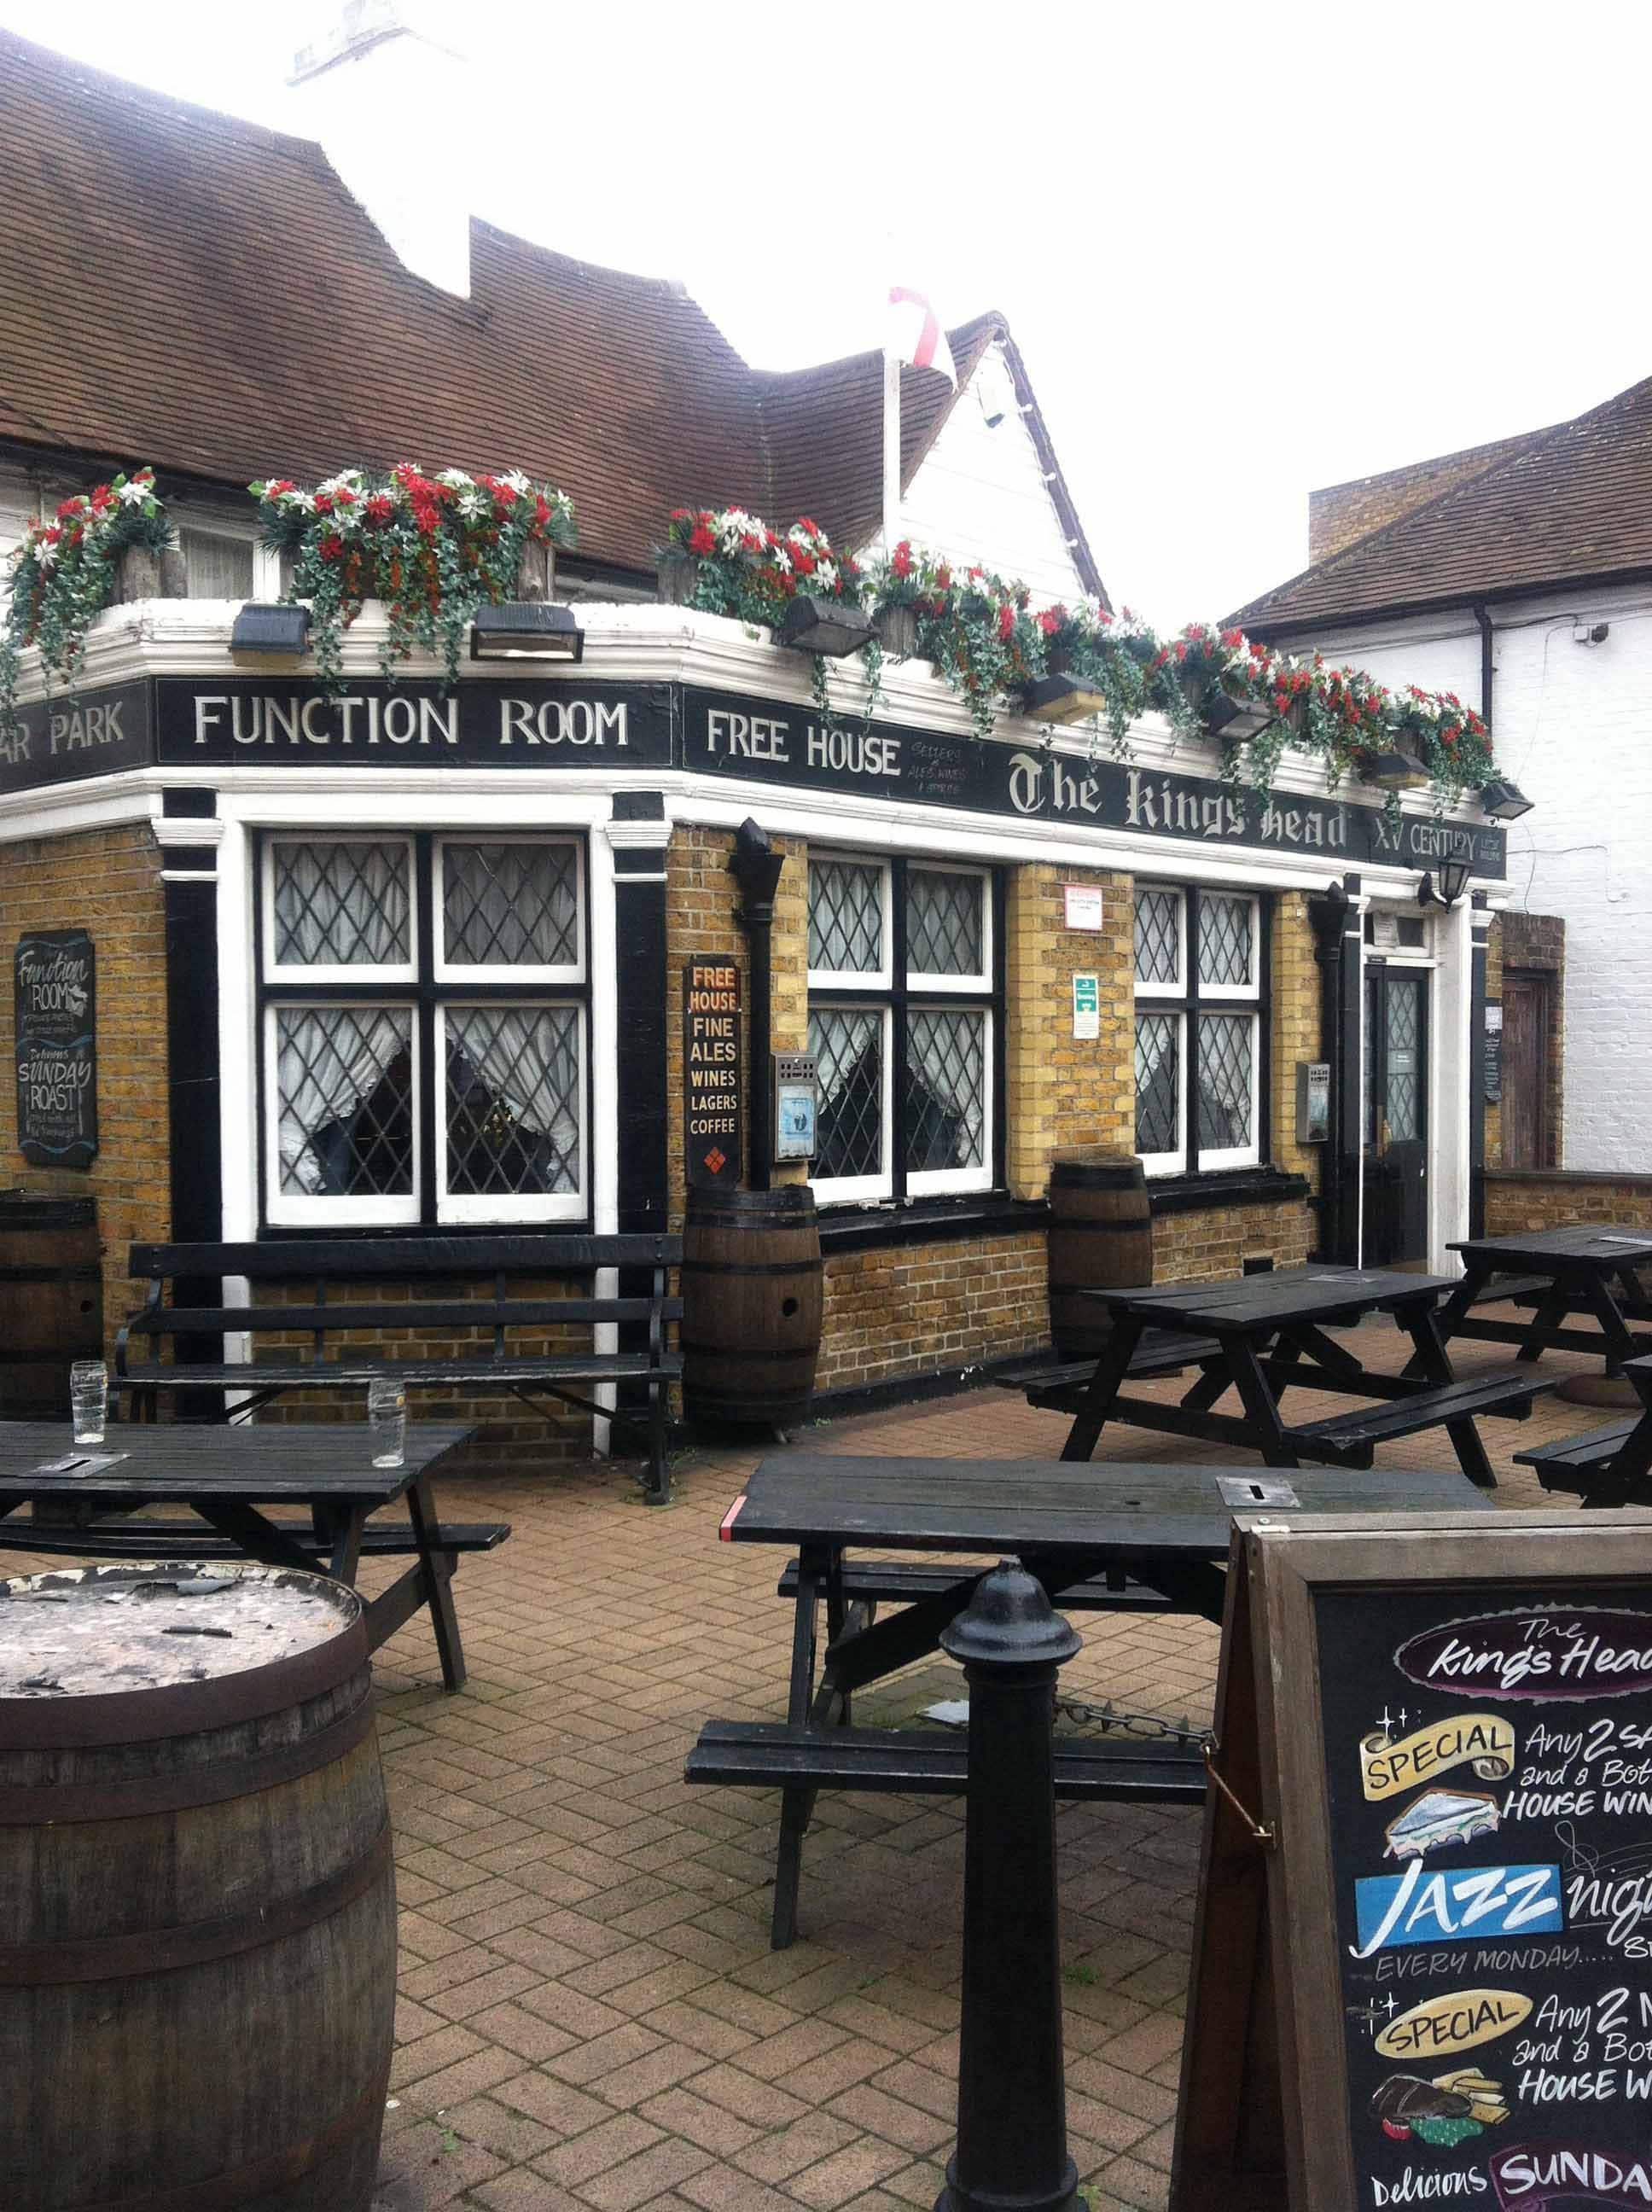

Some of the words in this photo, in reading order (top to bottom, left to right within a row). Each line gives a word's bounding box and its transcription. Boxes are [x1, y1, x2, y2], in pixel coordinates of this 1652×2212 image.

[49, 701, 124, 754] PARK
[194, 695, 459, 744] FUNCTION
[499, 699, 629, 747] ROOM
[707, 709, 789, 762] FREE
[807, 725, 901, 776] HOUSE
[1009, 753, 1102, 814] The
[693, 967, 736, 989] FREE
[32, 982, 68, 1011] ROOM
[689, 992, 737, 1012] HOUSE
[693, 1017, 734, 1037] FINE
[690, 1042, 736, 1062] ALES
[18, 1061, 91, 1088] SUNDAY
[691, 1070, 736, 1087] WINES
[31, 1085, 76, 1110] ROAST
[691, 1095, 737, 1111] LAGERS
[690, 1118, 735, 1134] COFFEE
[1517, 1618, 1587, 1641] The
[1525, 1723, 1583, 1765] Any
[1584, 1719, 1618, 1762] 2
[1367, 1725, 1513, 1790] SPECIAL
[1521, 1763, 1568, 1786] and
[1504, 1790, 1597, 1821] HOUSE
[1348, 1858, 1559, 1959] JAZZ
[1375, 1952, 1467, 1982] EVERY
[1386, 2000, 1519, 2052] SPECIAL
[1536, 1994, 1591, 2045] Any
[1597, 1988, 1630, 2034] 2
[1512, 2035, 1562, 2065] and
[1573, 2041, 1590, 2063] a
[1518, 2069, 1617, 2105] HOUSE
[1372, 2166, 1487, 2207] Delicious
